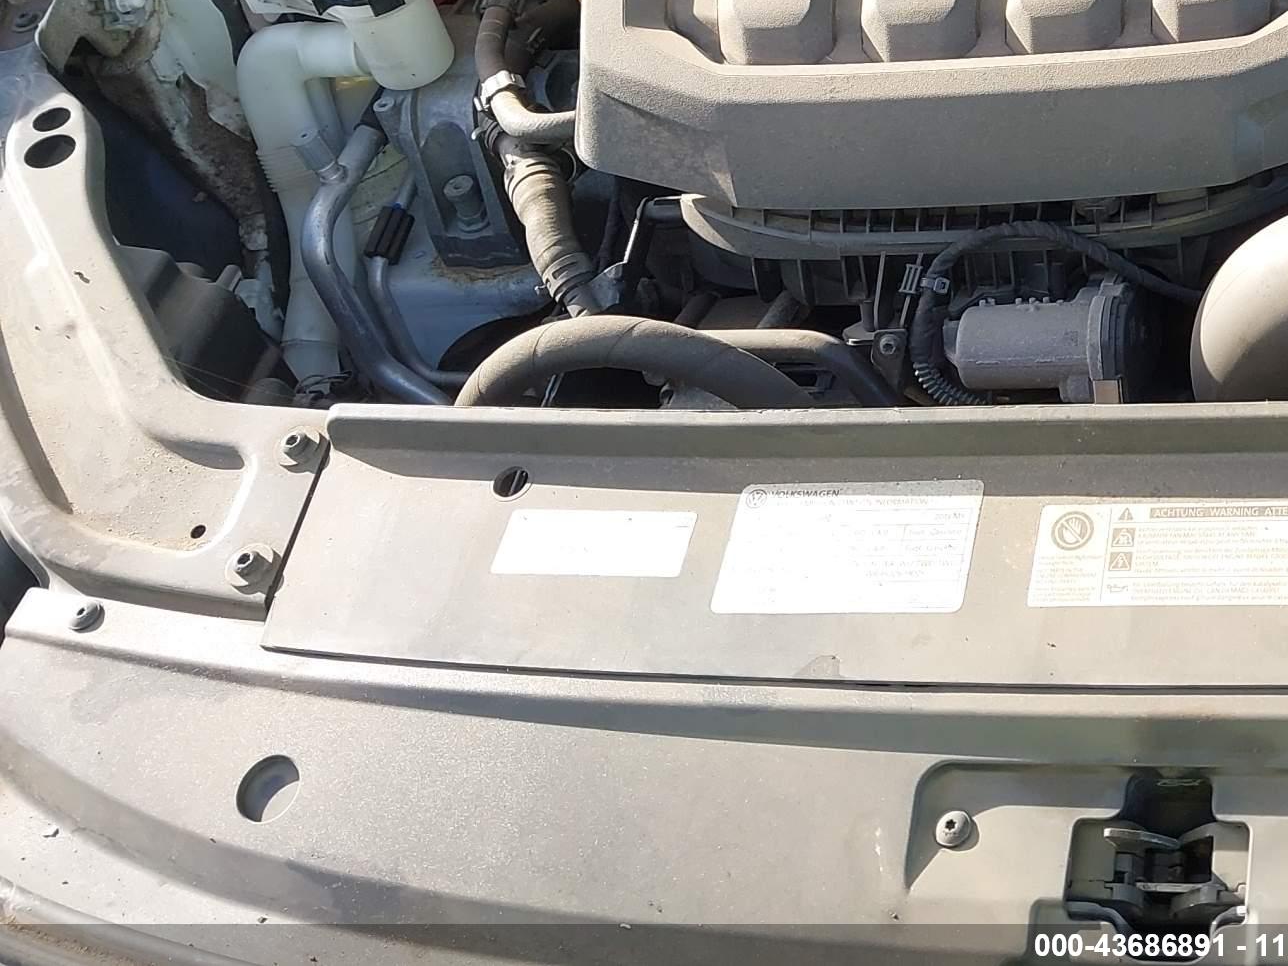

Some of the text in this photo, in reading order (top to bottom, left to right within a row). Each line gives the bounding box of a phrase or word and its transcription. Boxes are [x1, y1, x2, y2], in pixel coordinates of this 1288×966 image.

[769, 489, 840, 499] VOLKSWAGEN
[1153, 507, 1204, 518] ACHTUNG
[1210, 506, 1259, 517] WARNING
